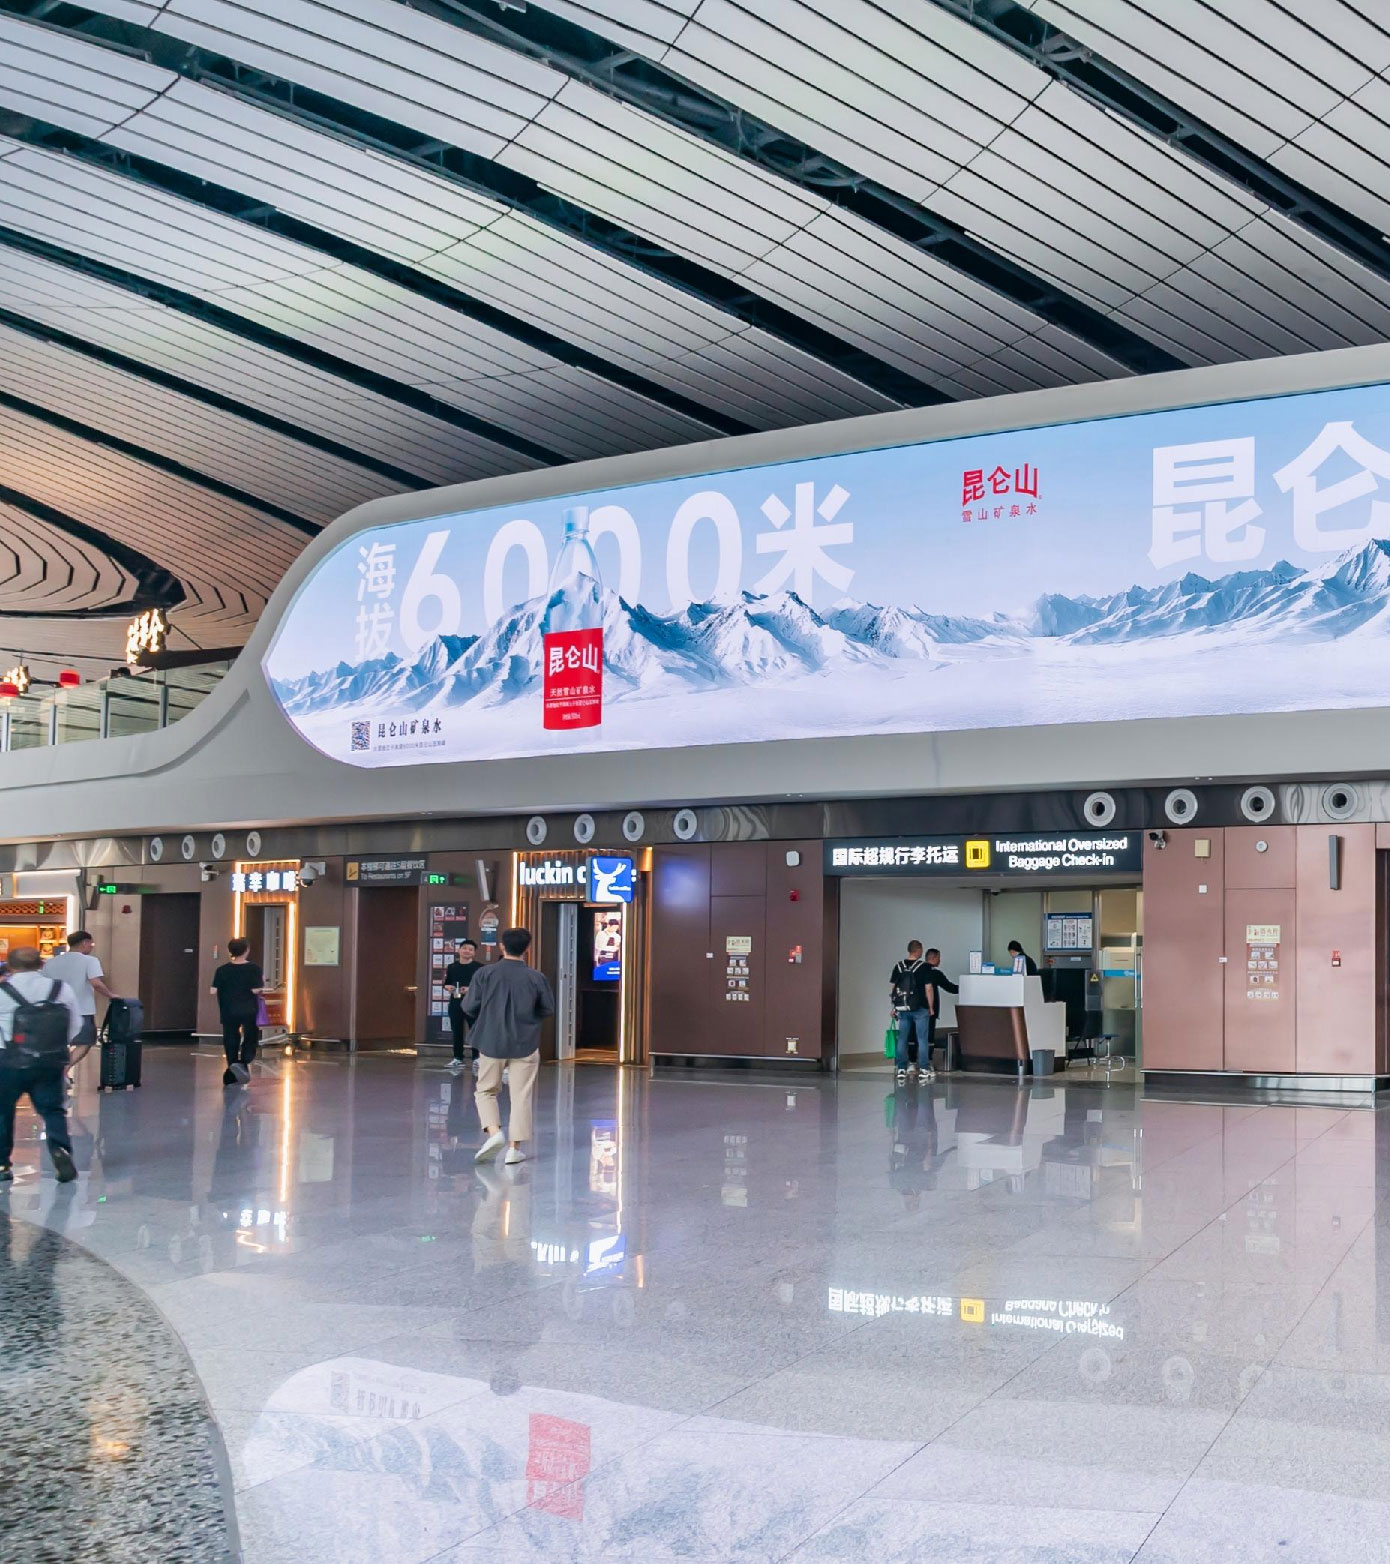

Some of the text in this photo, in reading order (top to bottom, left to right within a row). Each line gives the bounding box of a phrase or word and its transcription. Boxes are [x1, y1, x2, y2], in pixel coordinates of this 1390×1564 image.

[963, 462, 1039, 508] 昆仑山
[961, 502, 1038, 522] 雪山矿泉水
[354, 541, 398, 656] 海拔
[549, 643, 598, 677] 昆仑山
[378, 717, 442, 738] 昆仑山矿泉水
[996, 837, 1128, 854] International Oversized
[832, 846, 959, 867] 国际超规行李托运
[1008, 852, 1114, 871] Baggage Check-in
[520, 860, 573, 885] luckin
